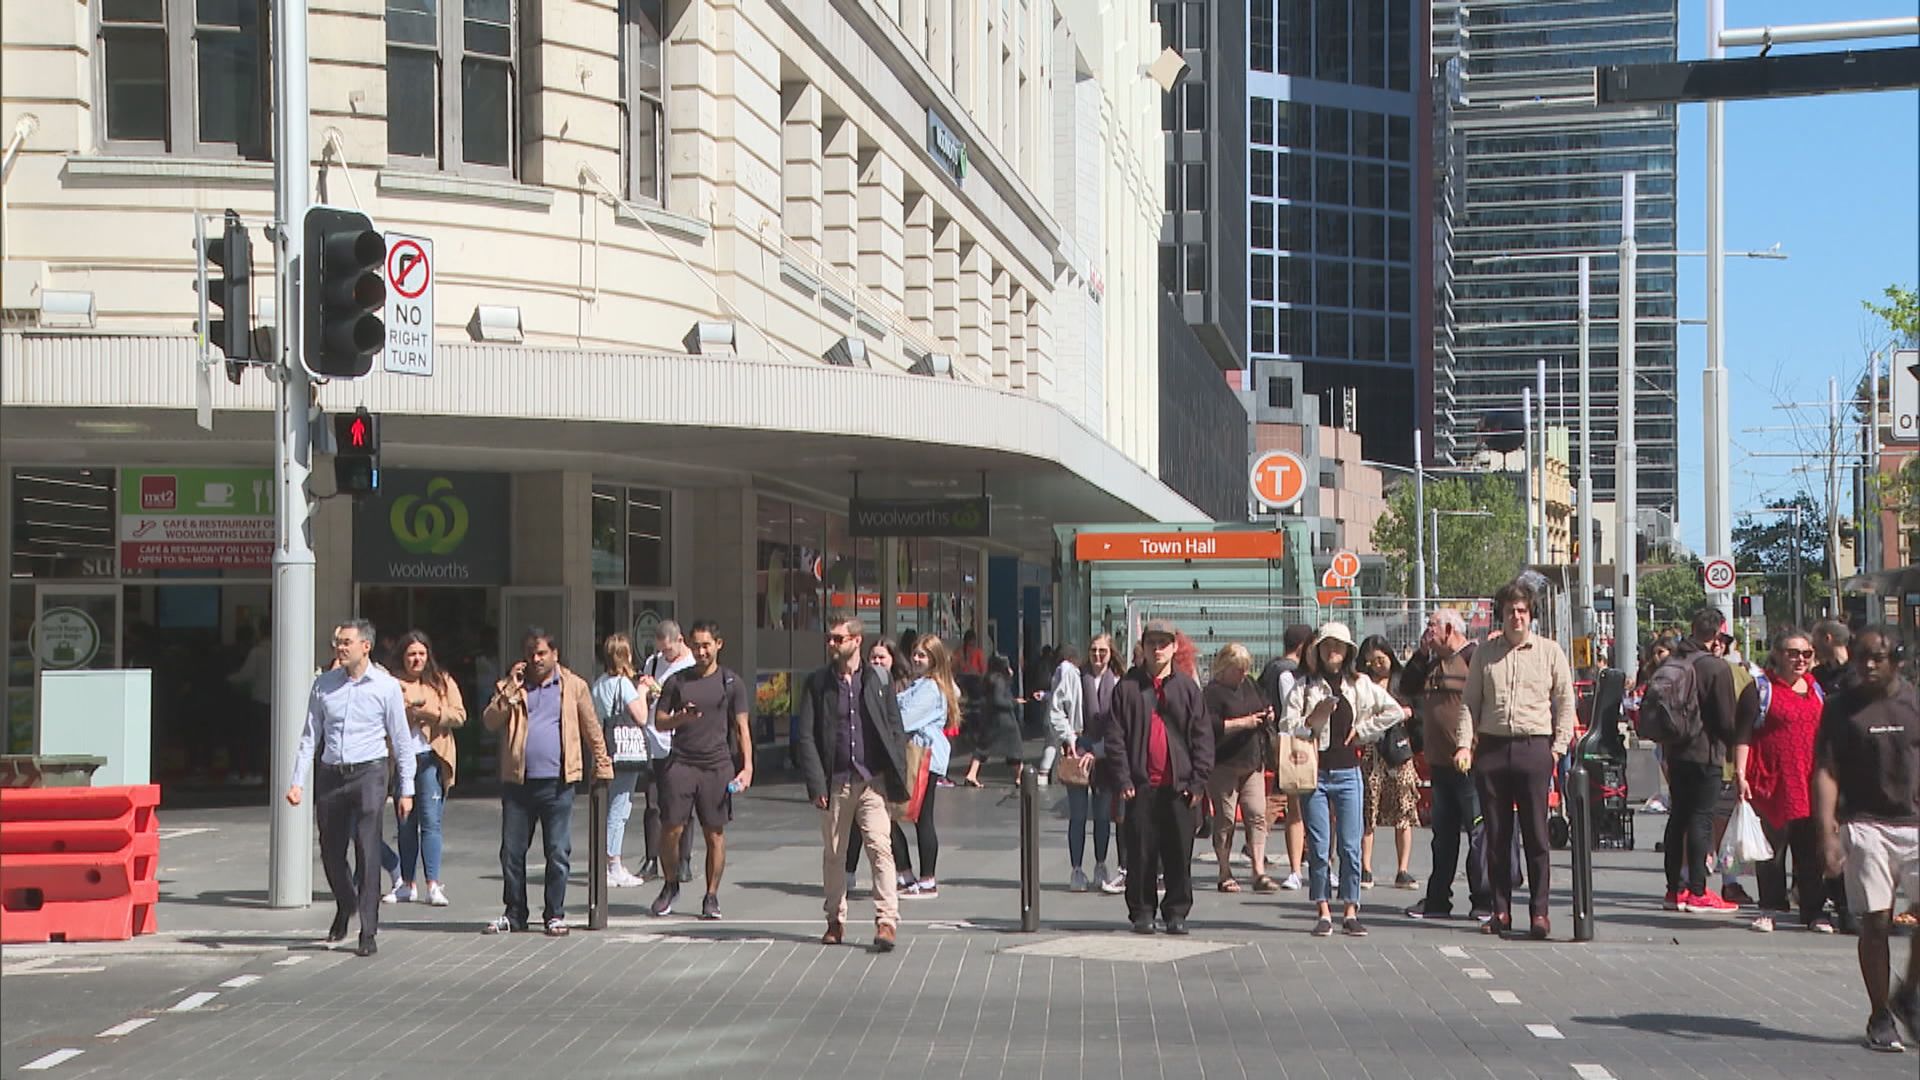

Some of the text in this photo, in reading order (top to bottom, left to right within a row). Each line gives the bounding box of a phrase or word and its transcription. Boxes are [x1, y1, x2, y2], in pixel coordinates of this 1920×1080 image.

[396, 304, 422, 325] NO
[389, 329, 428, 347] RIGHT
[391, 350, 427, 367] TURN
[1267, 465, 1291, 496] T
[163, 518, 188, 529] CAFÉ
[190, 520, 198, 528] &
[199, 520, 262, 529] RESTAURANT
[165, 530, 238, 539] WOOLWORTHS
[240, 530, 268, 539] LEVEL
[170, 546, 225, 554] RESTAURANT
[240, 546, 264, 554] LEVEL
[1139, 537, 1216, 554] Town Hall
[388, 561, 469, 578] Woolworths
[1711, 568, 1729, 581] 20
